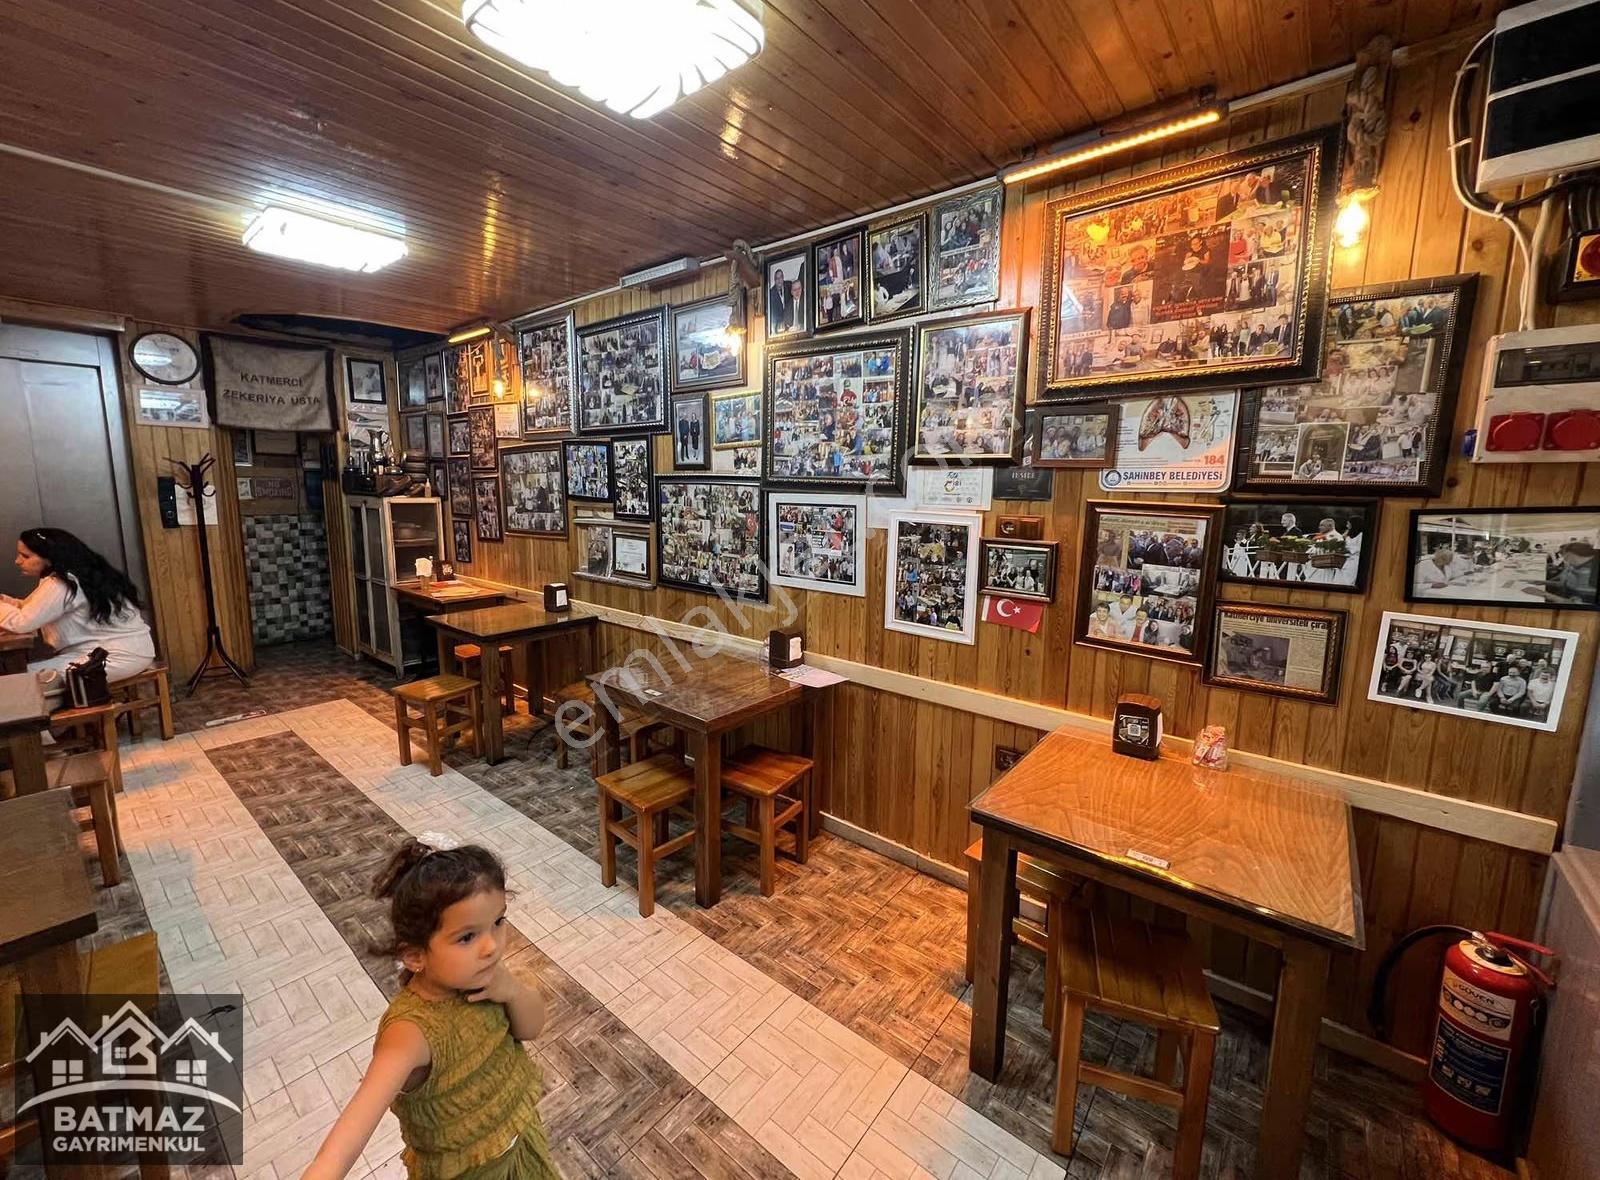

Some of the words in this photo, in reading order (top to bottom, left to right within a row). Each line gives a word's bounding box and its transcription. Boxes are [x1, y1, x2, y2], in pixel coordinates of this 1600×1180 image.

[223, 389, 286, 405] ZEKERİYA
[291, 396, 321, 406] USTA
[1203, 454, 1225, 466] 184
